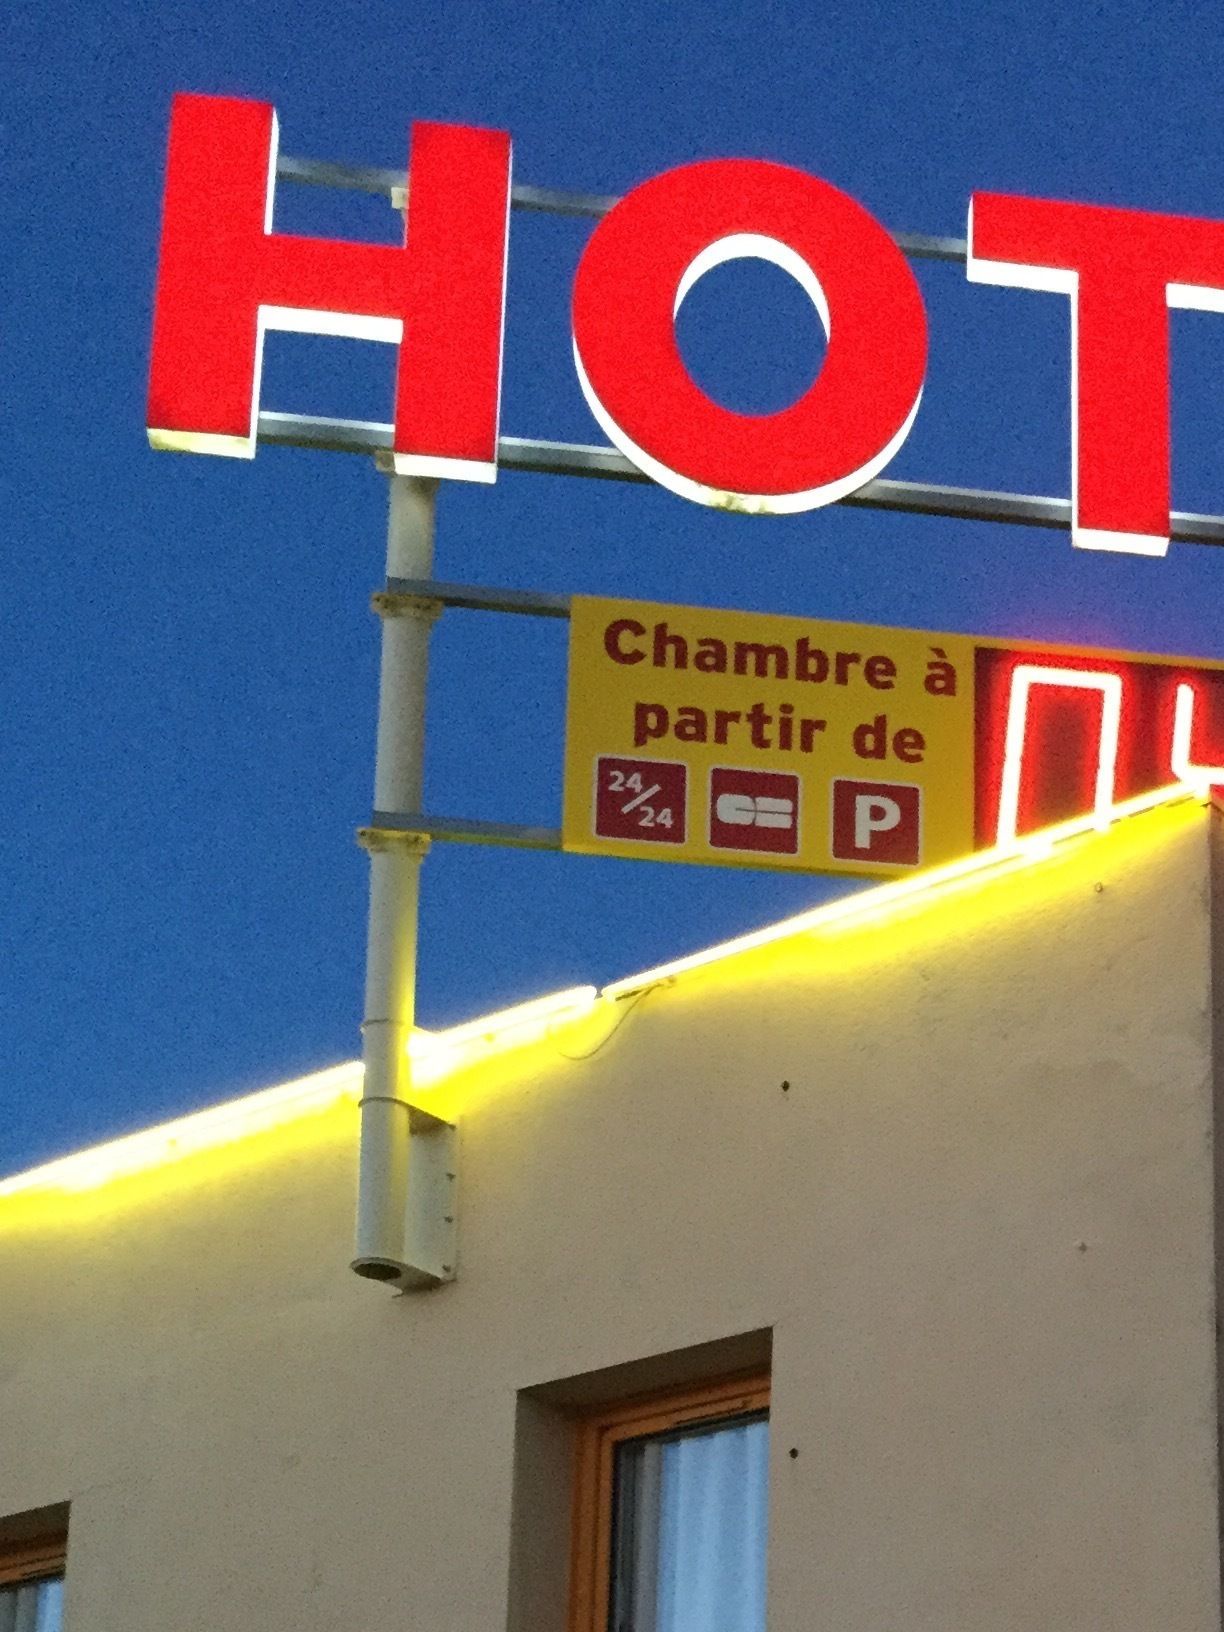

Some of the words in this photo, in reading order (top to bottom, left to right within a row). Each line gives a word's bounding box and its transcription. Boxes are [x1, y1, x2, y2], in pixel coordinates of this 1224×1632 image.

[604, 618, 896, 690] Chambre
[923, 646, 957, 697] à
[633, 701, 827, 753] partir
[852, 714, 926, 764] de
[853, 794, 901, 849] P
